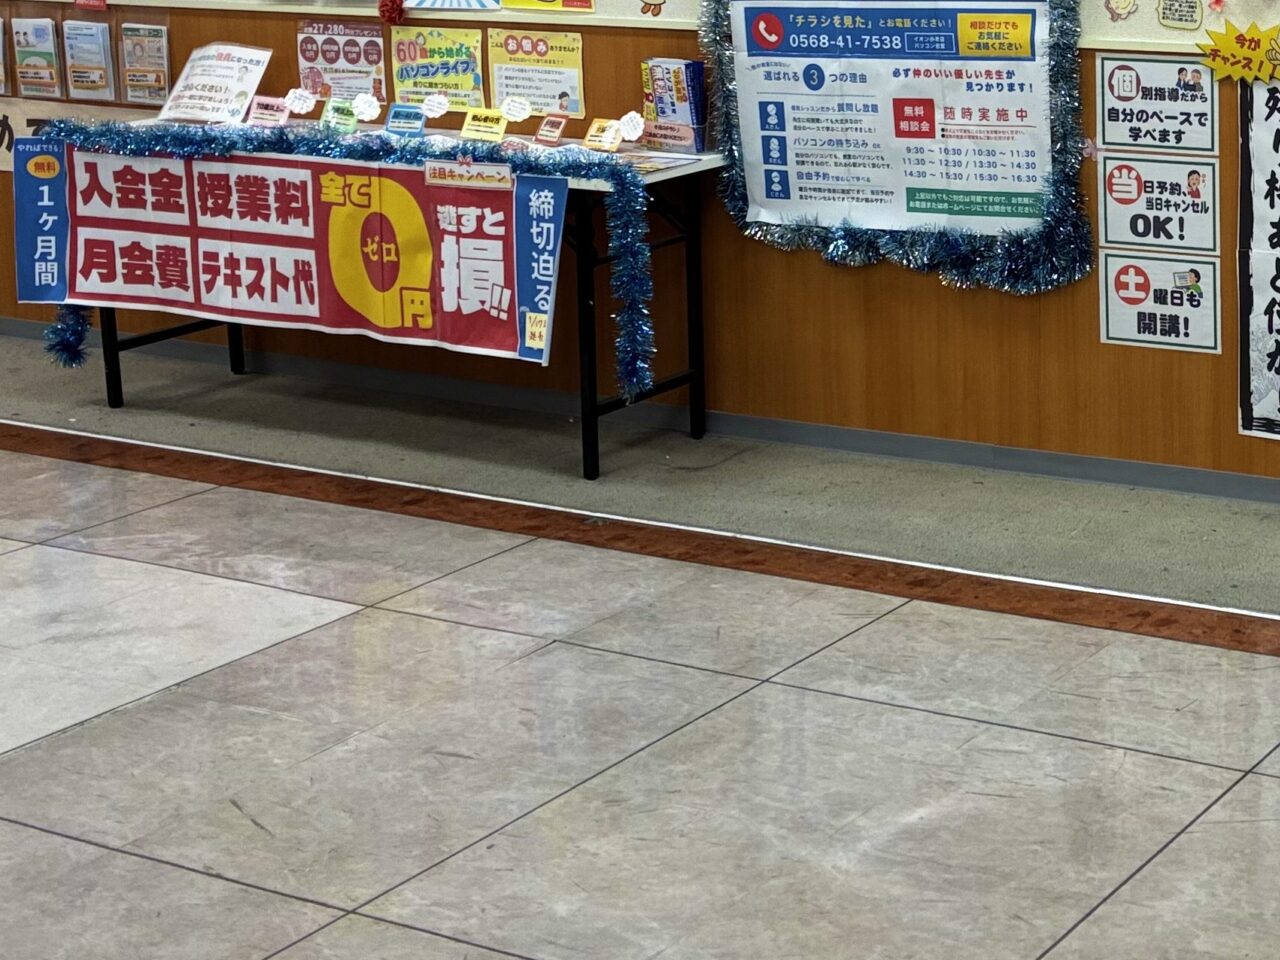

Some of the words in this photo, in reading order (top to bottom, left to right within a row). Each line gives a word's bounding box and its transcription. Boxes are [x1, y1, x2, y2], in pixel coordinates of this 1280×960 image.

[789, 34, 902, 49] 0568-41-7538
[1234, 33, 1261, 51] 今が
[965, 81, 1034, 93] 見つかります!
[1110, 68, 1209, 104] 個別指導だから
[903, 105, 925, 117] 無料
[1107, 106, 1209, 128] 自分のペースで
[899, 120, 931, 132] 相談会
[1128, 126, 1187, 144] 学べます
[33, 160, 57, 173] 無料
[429, 167, 506, 184] 注目キャンペーン
[79, 160, 185, 215] 入会金
[197, 170, 312, 227] 授業料
[319, 172, 373, 208] 全て
[1145, 197, 1210, 214] 当日キャンセル
[436, 204, 507, 236] 逃すと
[1129, 213, 1186, 241] OK!
[361, 235, 400, 265] ゼロ
[528, 188, 555, 312] 締切迫る
[78, 237, 191, 292] 月会費
[200, 249, 317, 308] テキスト代
[1136, 311, 1191, 339] 開講!
